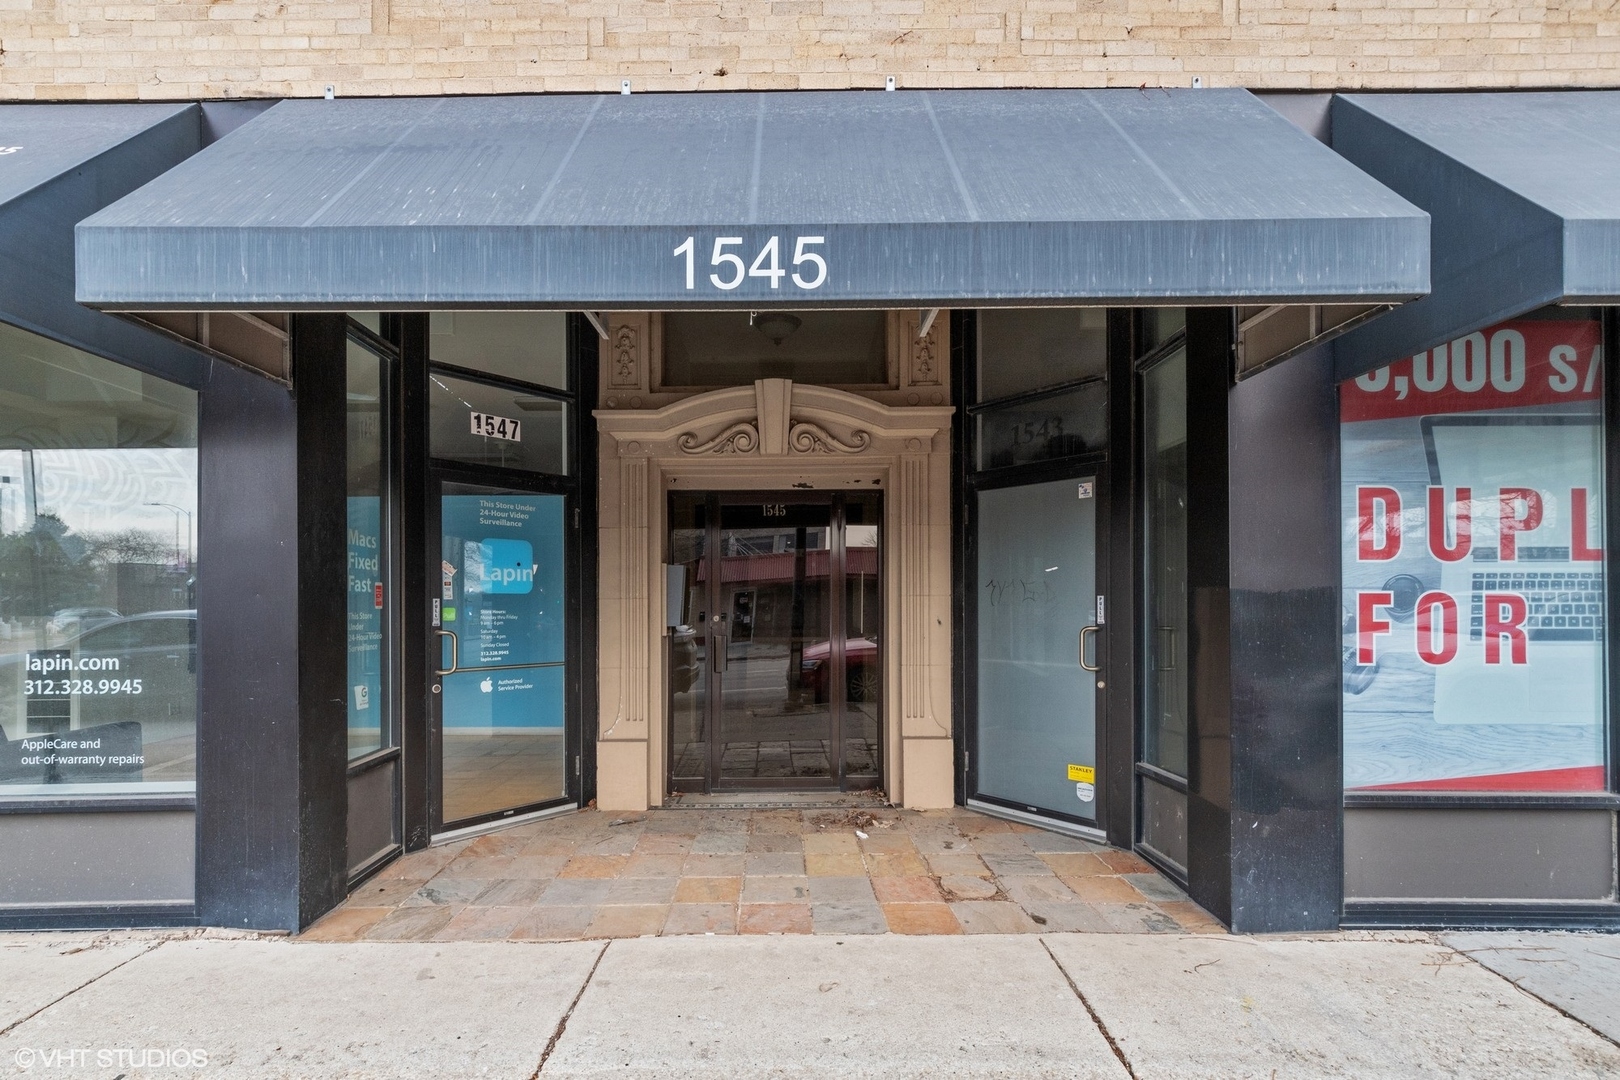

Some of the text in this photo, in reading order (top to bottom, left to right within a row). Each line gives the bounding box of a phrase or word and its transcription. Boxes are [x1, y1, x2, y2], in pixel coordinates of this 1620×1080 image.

[673, 235, 827, 290] 1545
[473, 413, 519, 440] 1547
[1011, 416, 1064, 446] 1543
[480, 500, 536, 512] This Store Under
[480, 509, 529, 520] 24-Hour Video
[763, 504, 786, 516] 1545
[480, 518, 522, 527] Surveillance
[1356, 484, 1604, 562] DUPL
[348, 529, 376, 548] Macs
[348, 552, 378, 571] Fixed
[348, 575, 371, 592] Fast
[1356, 590, 1529, 666] FOR
[25, 653, 120, 675] lapin.com
[23, 679, 143, 695] 312.328.9945
[21, 738, 101, 751] AppleCare and
[21, 754, 145, 767] out-of-warranty repairs
